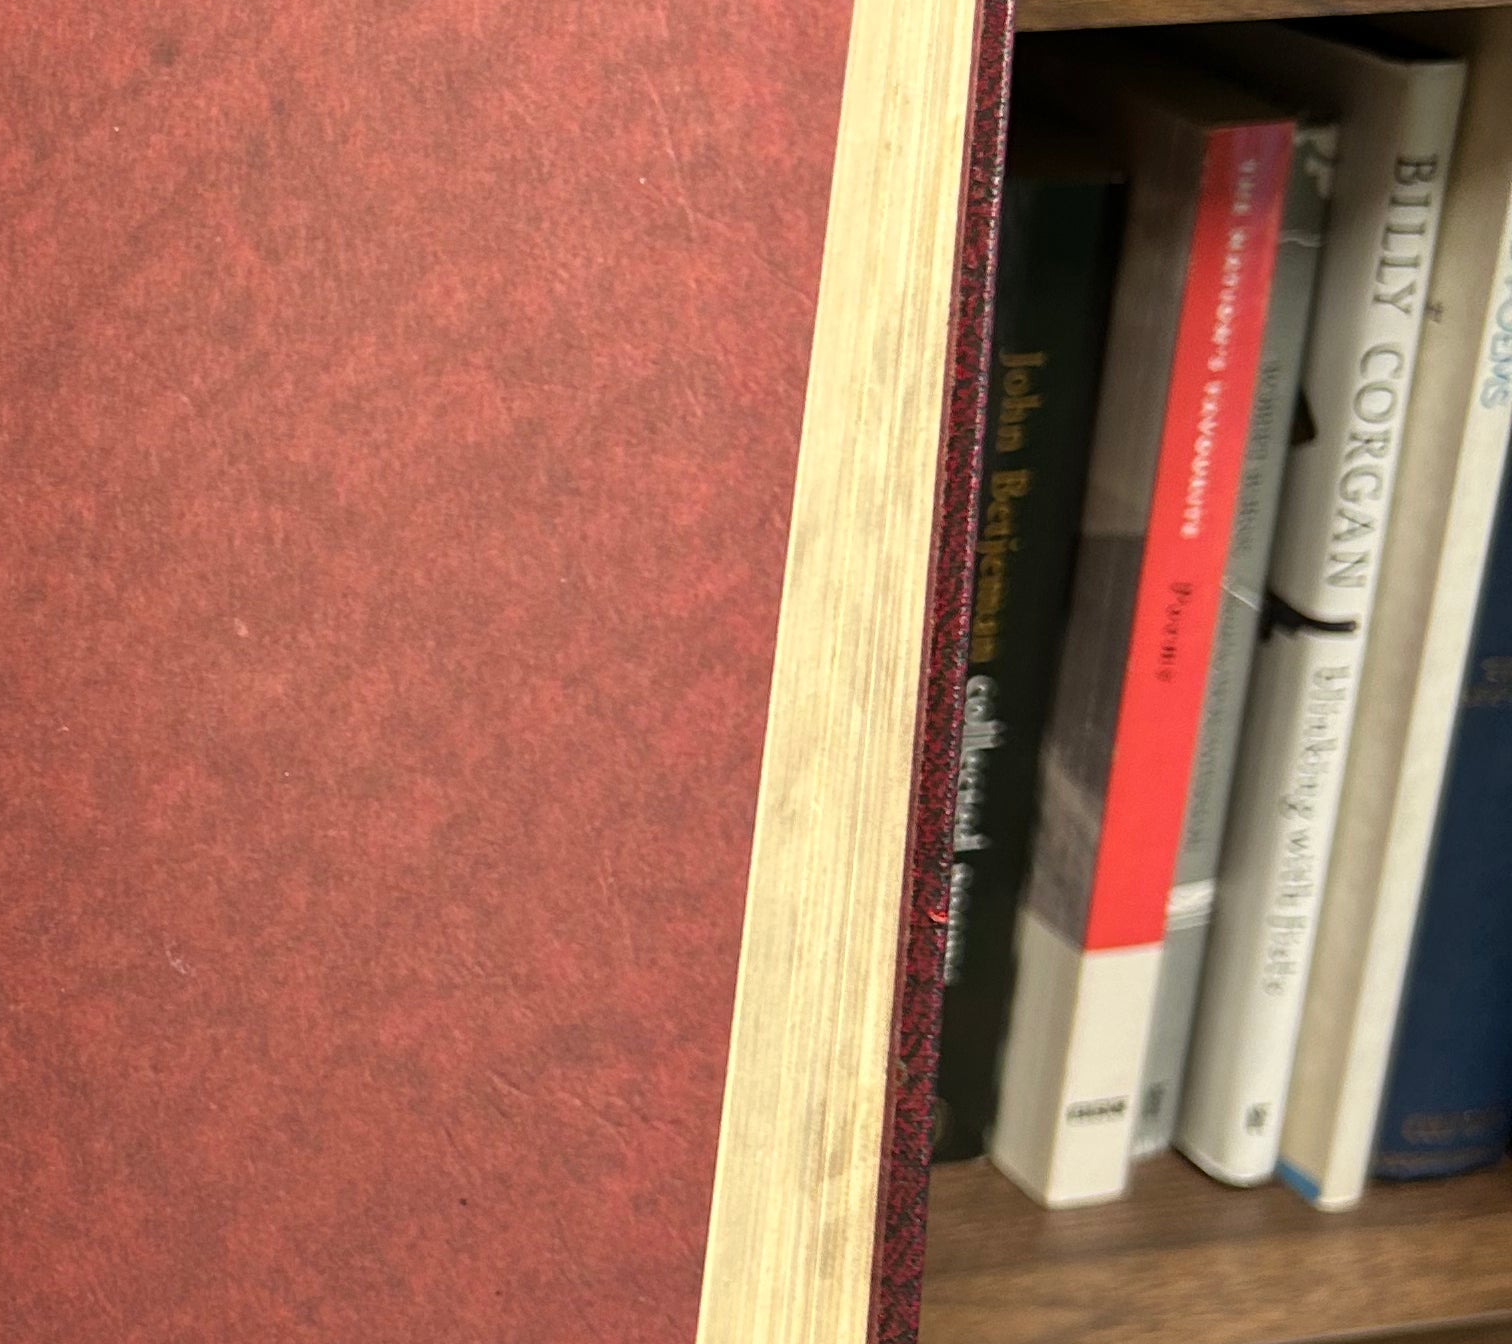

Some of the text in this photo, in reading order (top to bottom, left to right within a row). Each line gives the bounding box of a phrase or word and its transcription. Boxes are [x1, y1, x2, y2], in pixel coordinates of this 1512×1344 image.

[995, 350, 1045, 453] John
[1325, 155, 1437, 589] BILLY CORGAN
